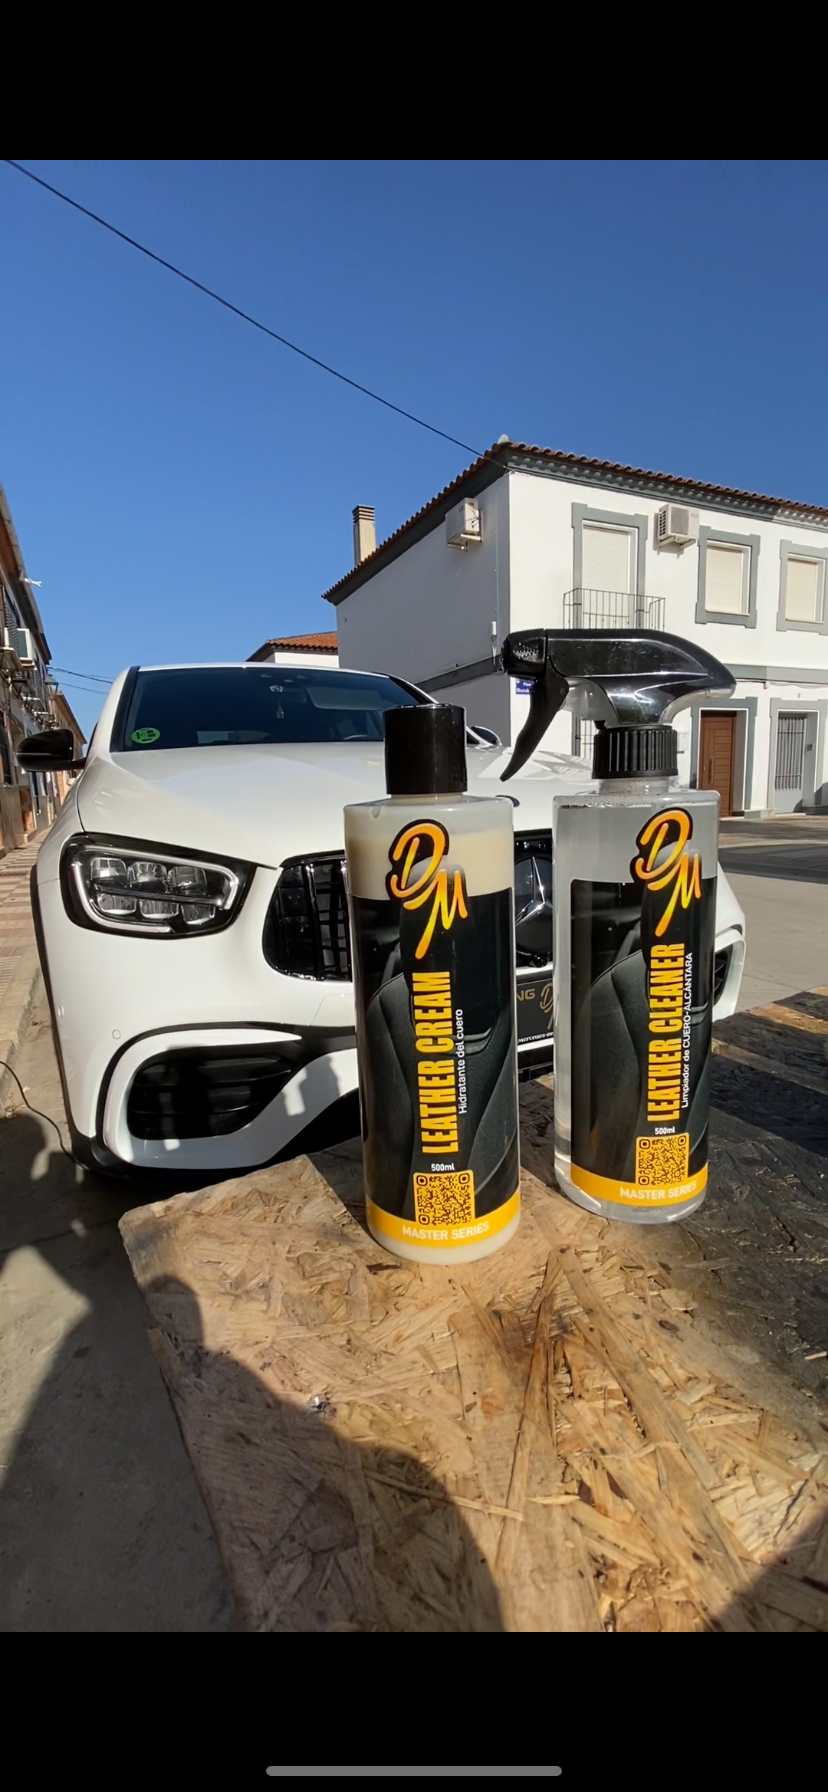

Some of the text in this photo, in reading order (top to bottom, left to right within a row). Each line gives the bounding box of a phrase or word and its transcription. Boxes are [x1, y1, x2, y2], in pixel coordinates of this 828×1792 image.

[647, 943, 685, 1122] LEATHER CLEANER
[412, 971, 459, 1154] LEATHER CREAM
[455, 1008, 468, 1114] Hidratante del cuero
[682, 1050, 691, 1062] de
[681, 1063, 691, 1108] Limpiador
[655, 1126, 676, 1135] 500ml
[430, 1162, 455, 1172] 500ml
[620, 1180, 698, 1200] MASTER SERIES
[402, 1221, 489, 1240] MASTER SERIES
